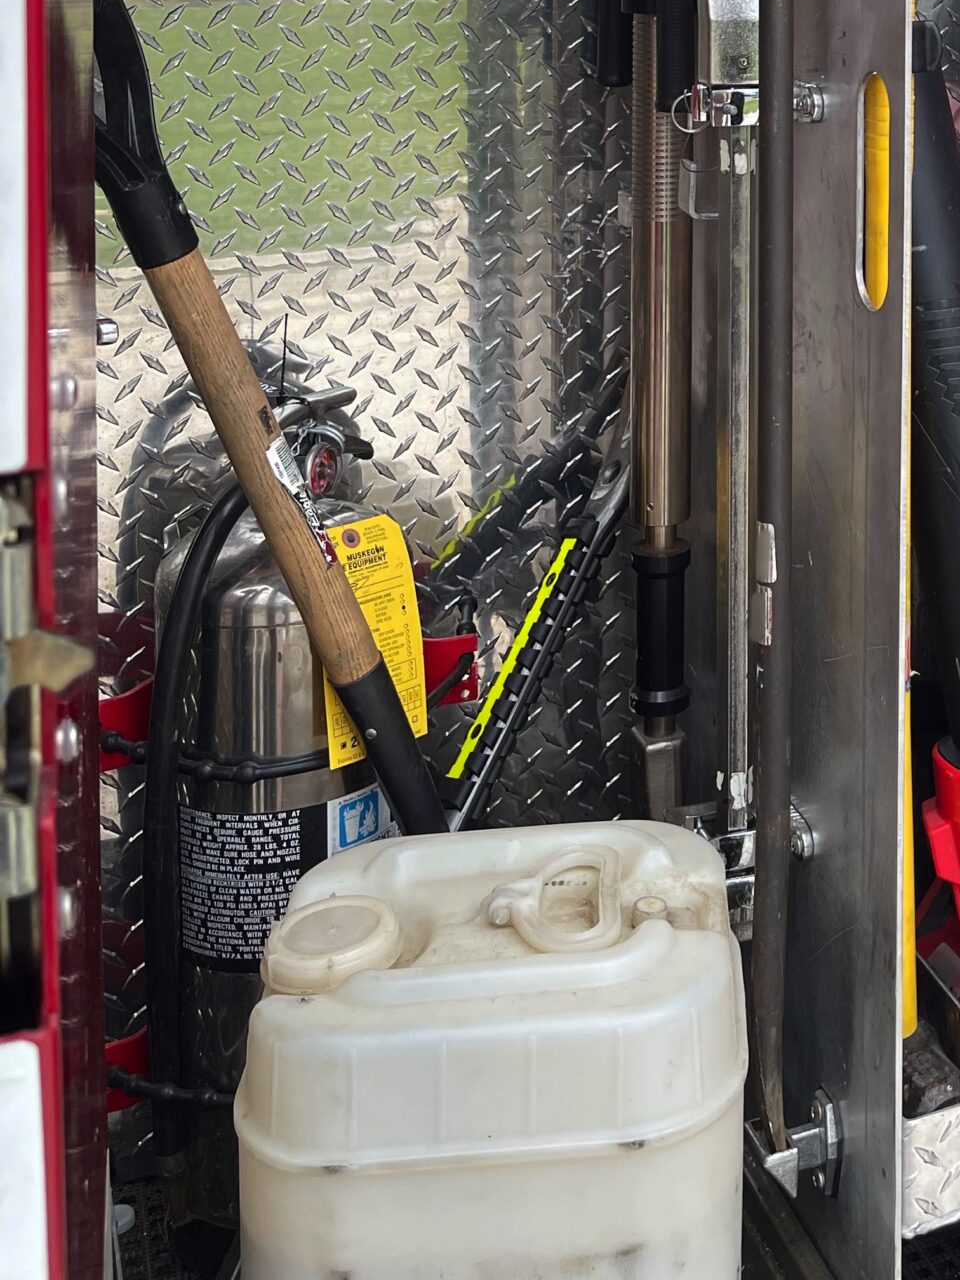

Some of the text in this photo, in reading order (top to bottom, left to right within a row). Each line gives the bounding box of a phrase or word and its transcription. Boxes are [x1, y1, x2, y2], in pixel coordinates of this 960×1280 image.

[347, 544, 384, 561] MUSKEGON
[348, 554, 387, 570] EQUIPMENT
[269, 825, 300, 834] PRESSURE
[280, 833, 300, 841] TOTAL
[203, 841, 222, 849] WEIGHT
[276, 847, 300, 856] NOZZLE
[285, 854, 300, 862] WIRE
[204, 871, 240, 880] IMMEDIATELY
[283, 869, 300, 877] HAVE
[213, 879, 246, 887] RECHARGED
[207, 914, 230, 922] CALCIUM
[208, 929, 243, 938] ACCORDANCE
[207, 935, 217, 943] THE
